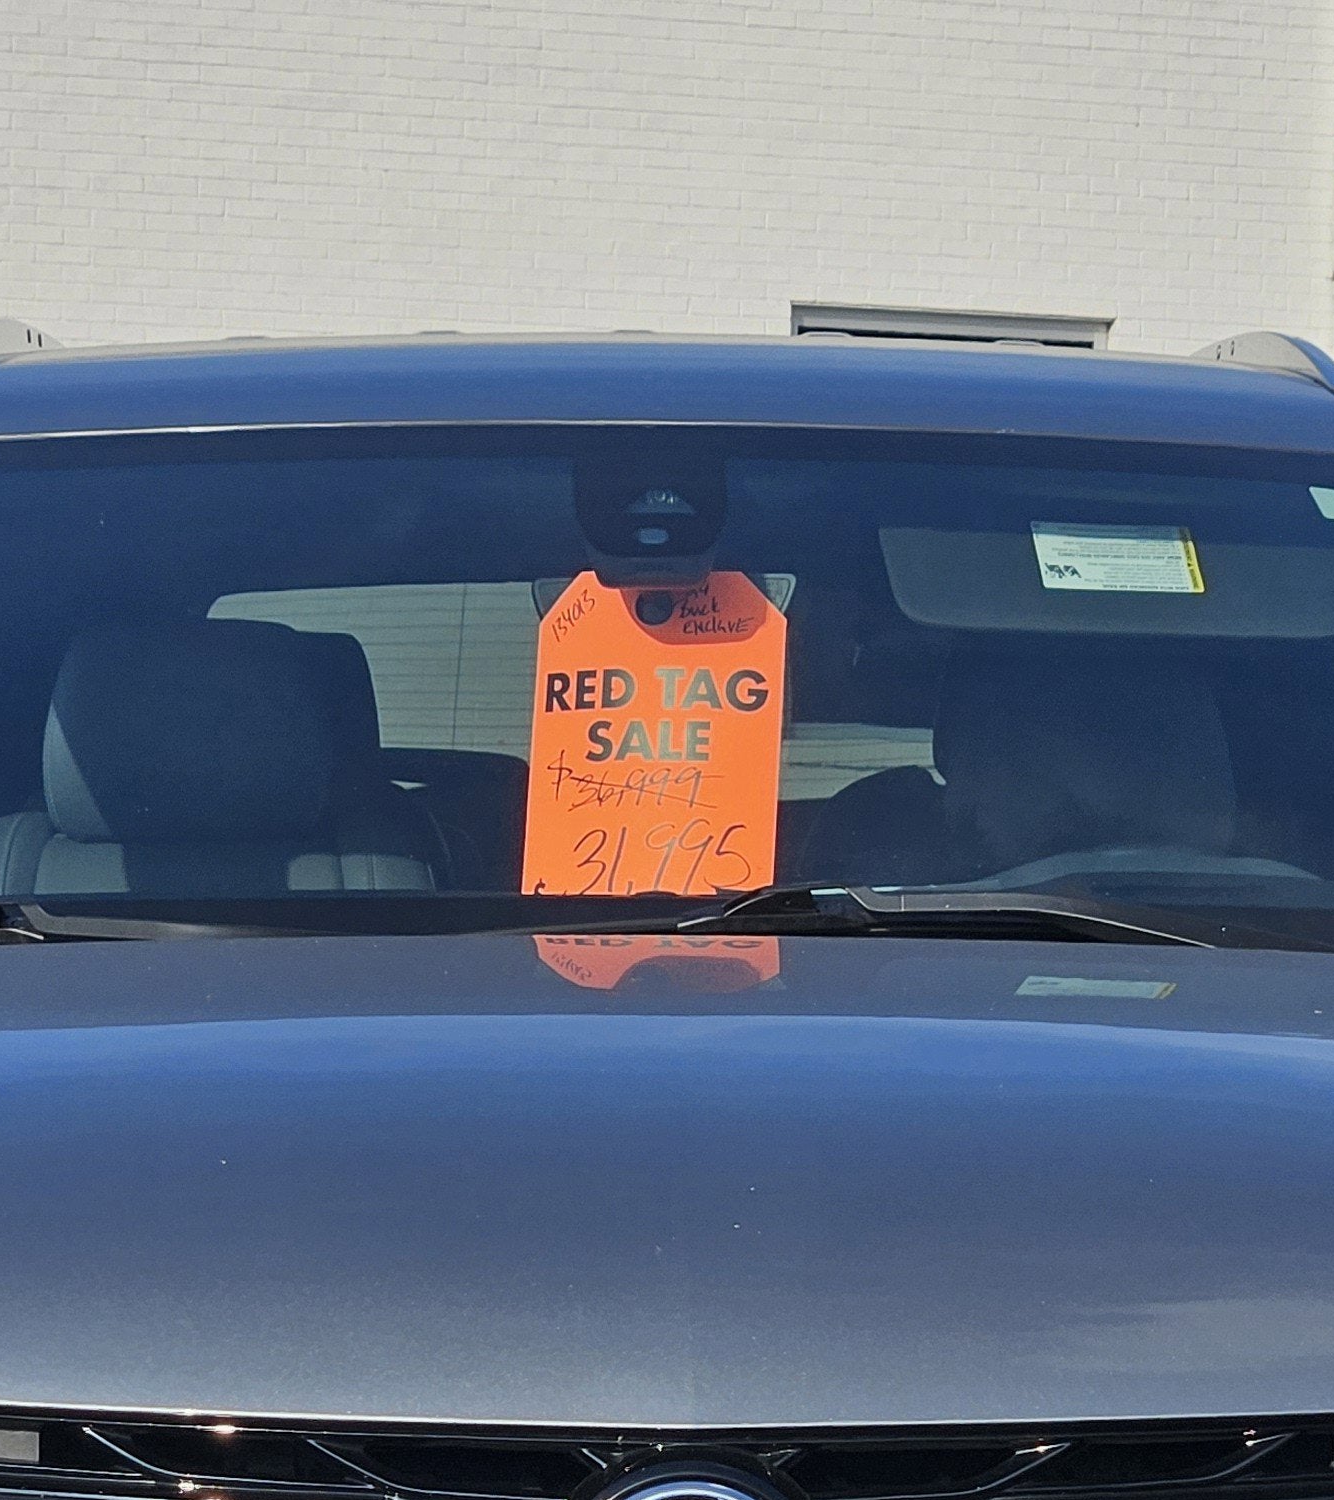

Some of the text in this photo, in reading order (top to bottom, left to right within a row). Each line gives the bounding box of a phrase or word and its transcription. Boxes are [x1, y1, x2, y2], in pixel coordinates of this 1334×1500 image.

[545, 669, 769, 712] RED TAG
[586, 721, 711, 762] SALE
[573, 819, 751, 895] 31,995
